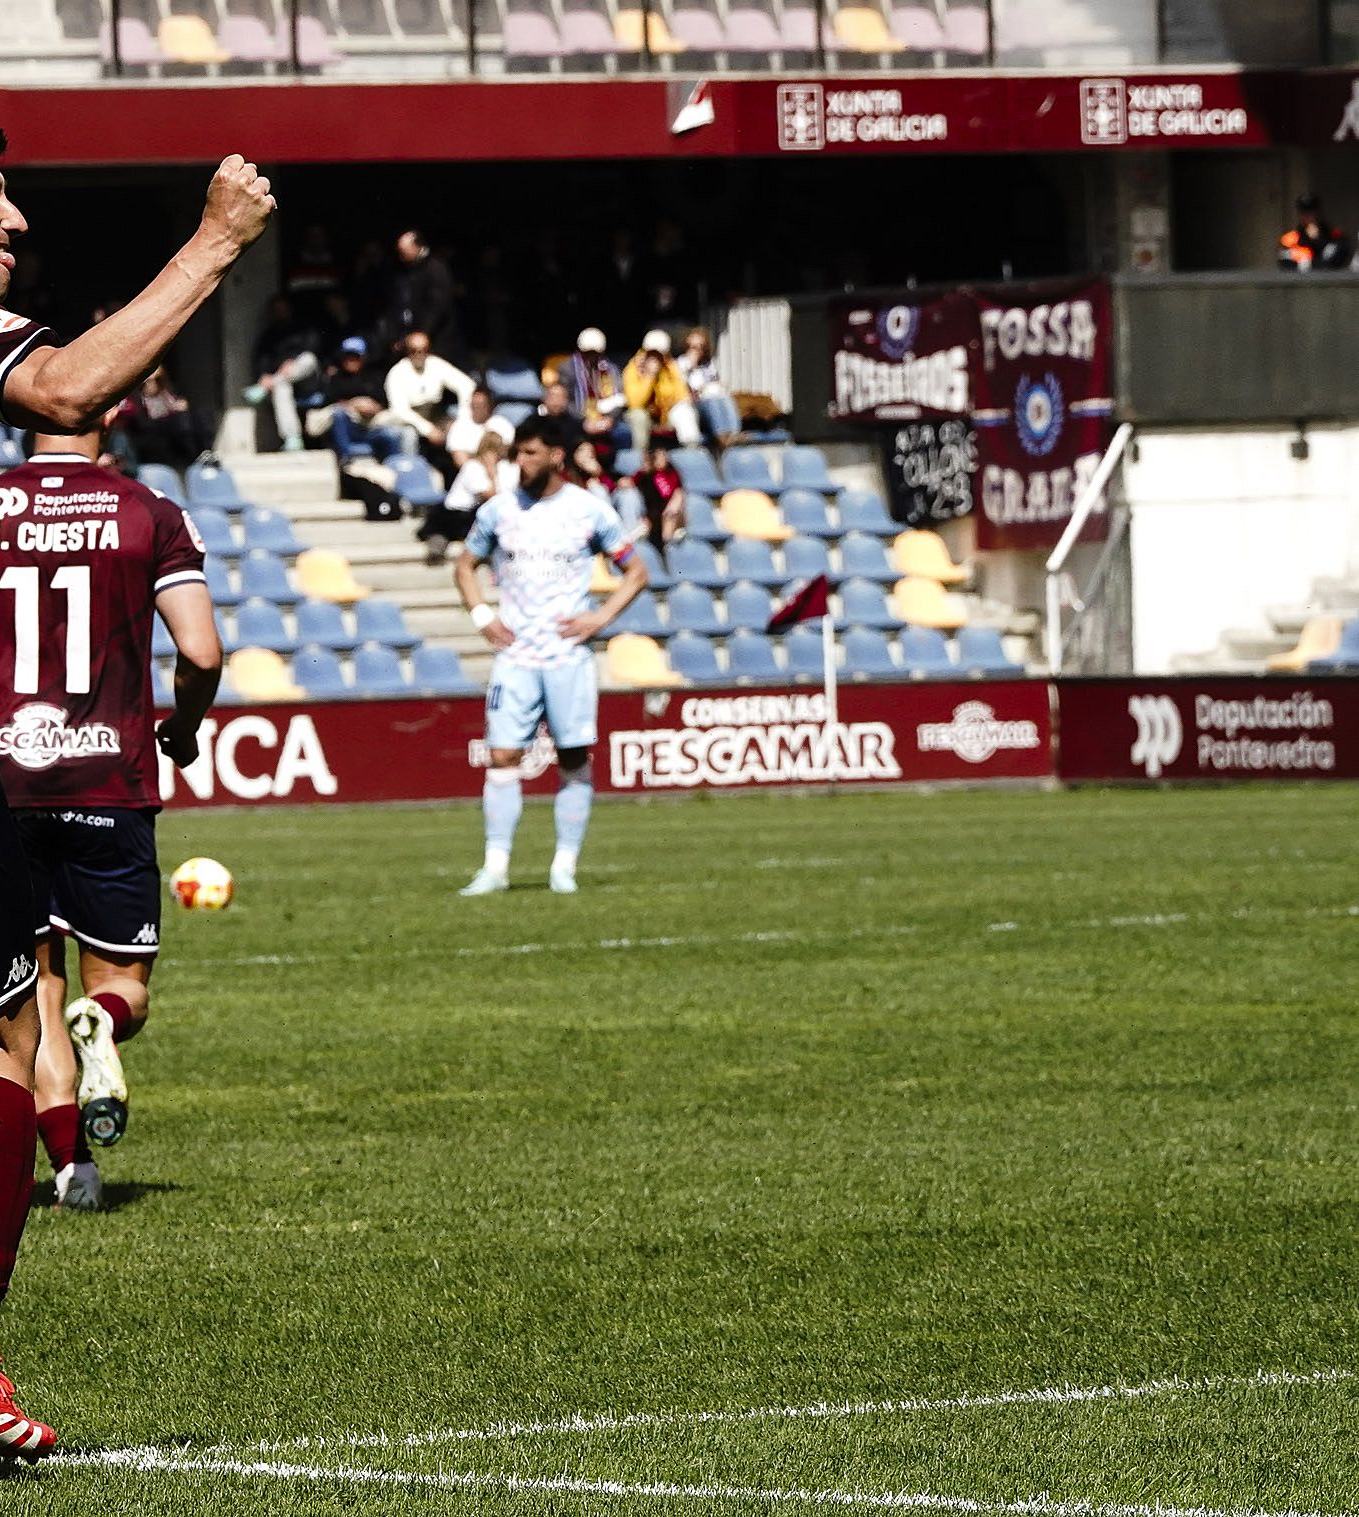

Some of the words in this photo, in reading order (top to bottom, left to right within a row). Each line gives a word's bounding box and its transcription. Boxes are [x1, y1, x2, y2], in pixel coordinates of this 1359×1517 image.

[826, 89, 902, 116] XUNTA
[1128, 84, 1203, 110] XUNTA
[826, 116, 857, 142] DE
[857, 114, 948, 142] GALICIA
[1128, 110, 1158, 136] DE
[1158, 108, 1247, 135] GALICIA
[980, 300, 1097, 371] FOSSA
[33, 503, 118, 516] Pontevedra
[34, 491, 119, 507] Deputación
[17, 520, 120, 552] CUESTA
[681, 694, 826, 727] CONSERVAS
[1195, 691, 1334, 738] Deputación
[609, 721, 902, 787] PESCAMAR
[1196, 734, 1336, 770] Pontevedra
